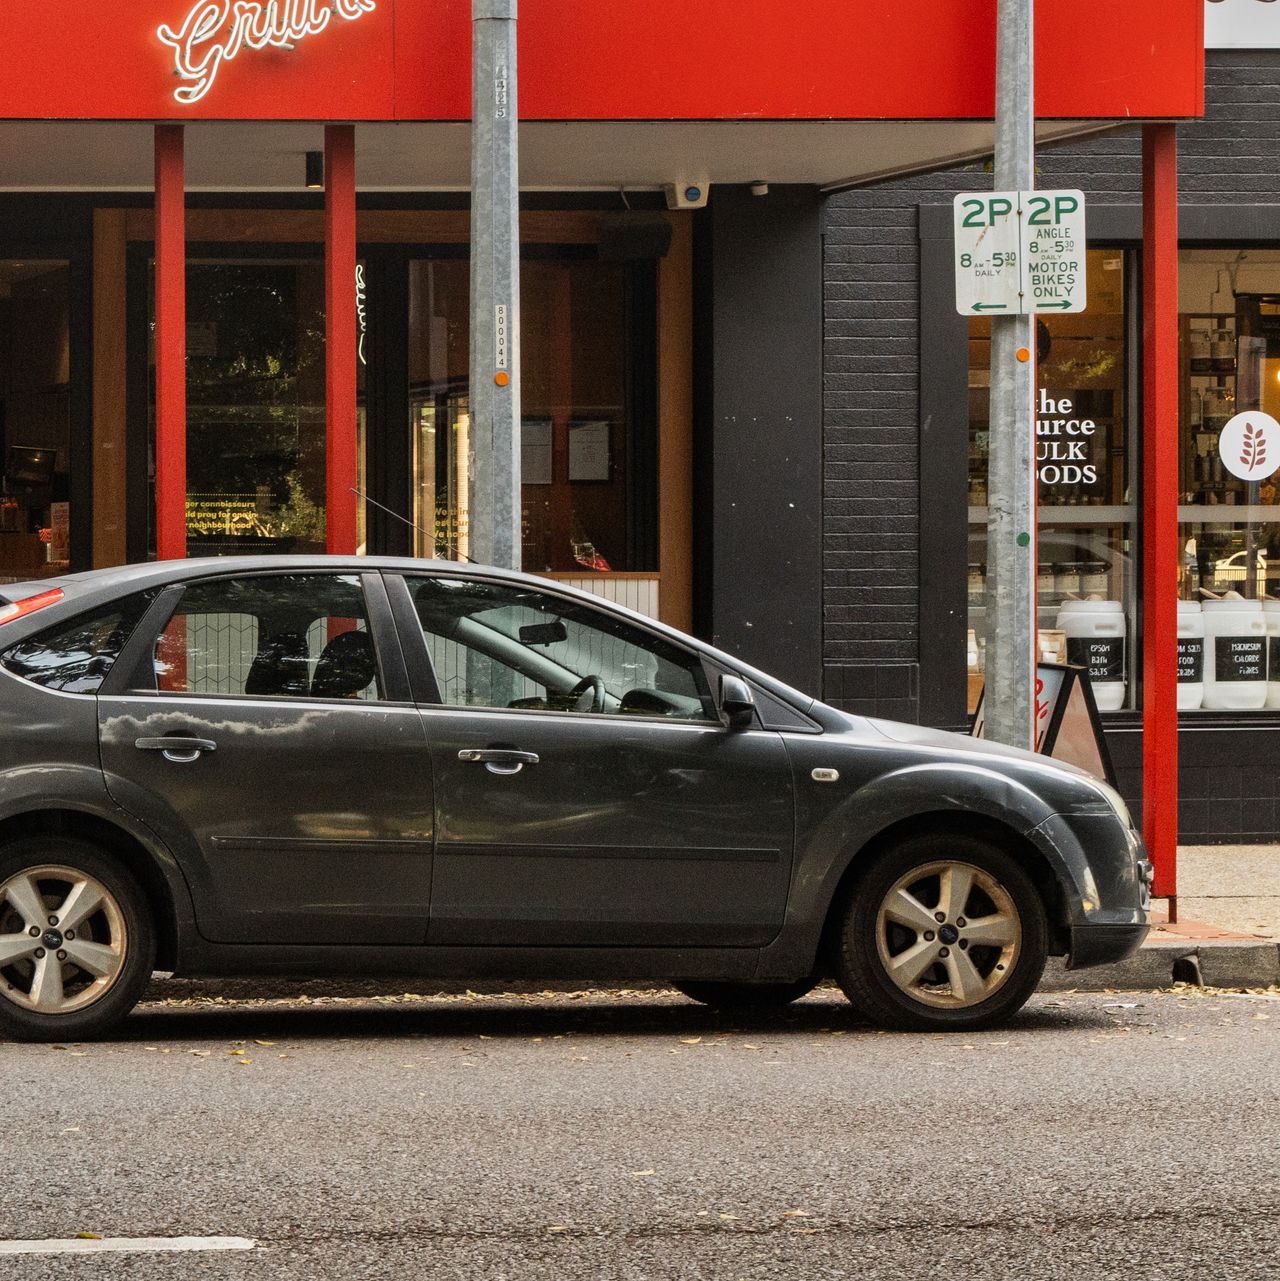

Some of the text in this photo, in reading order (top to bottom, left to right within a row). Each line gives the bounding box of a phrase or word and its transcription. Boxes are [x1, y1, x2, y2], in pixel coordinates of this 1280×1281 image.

[962, 199, 1013, 228] 2P
[1027, 196, 1078, 225] 2P
[1036, 228, 1071, 239] ANGLE
[1029, 262, 1078, 273] MOTOR
[1032, 274, 1075, 285] BIKES
[1033, 286, 1074, 297] ONLY
[1036, 388, 1072, 414] he
[1036, 419, 1096, 435] urce
[1036, 441, 1087, 461] ULK
[1036, 465, 1097, 484] ODS
